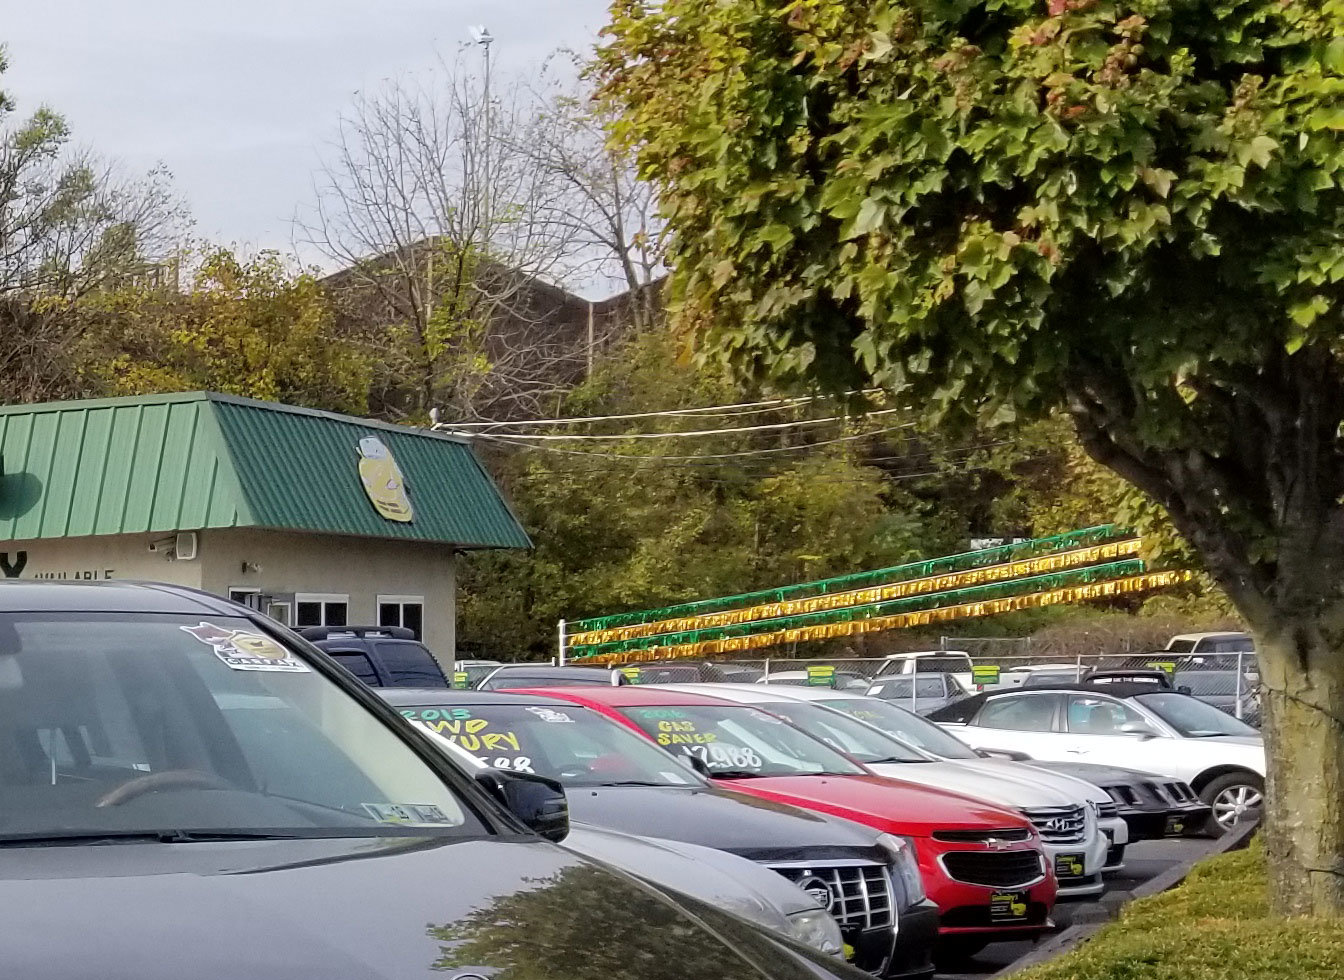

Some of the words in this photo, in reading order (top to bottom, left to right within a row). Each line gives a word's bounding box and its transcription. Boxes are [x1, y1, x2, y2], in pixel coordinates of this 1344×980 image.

[400, 708, 472, 721] 2013
[426, 719, 489, 735] WD
[658, 732, 717, 745] SAVER
